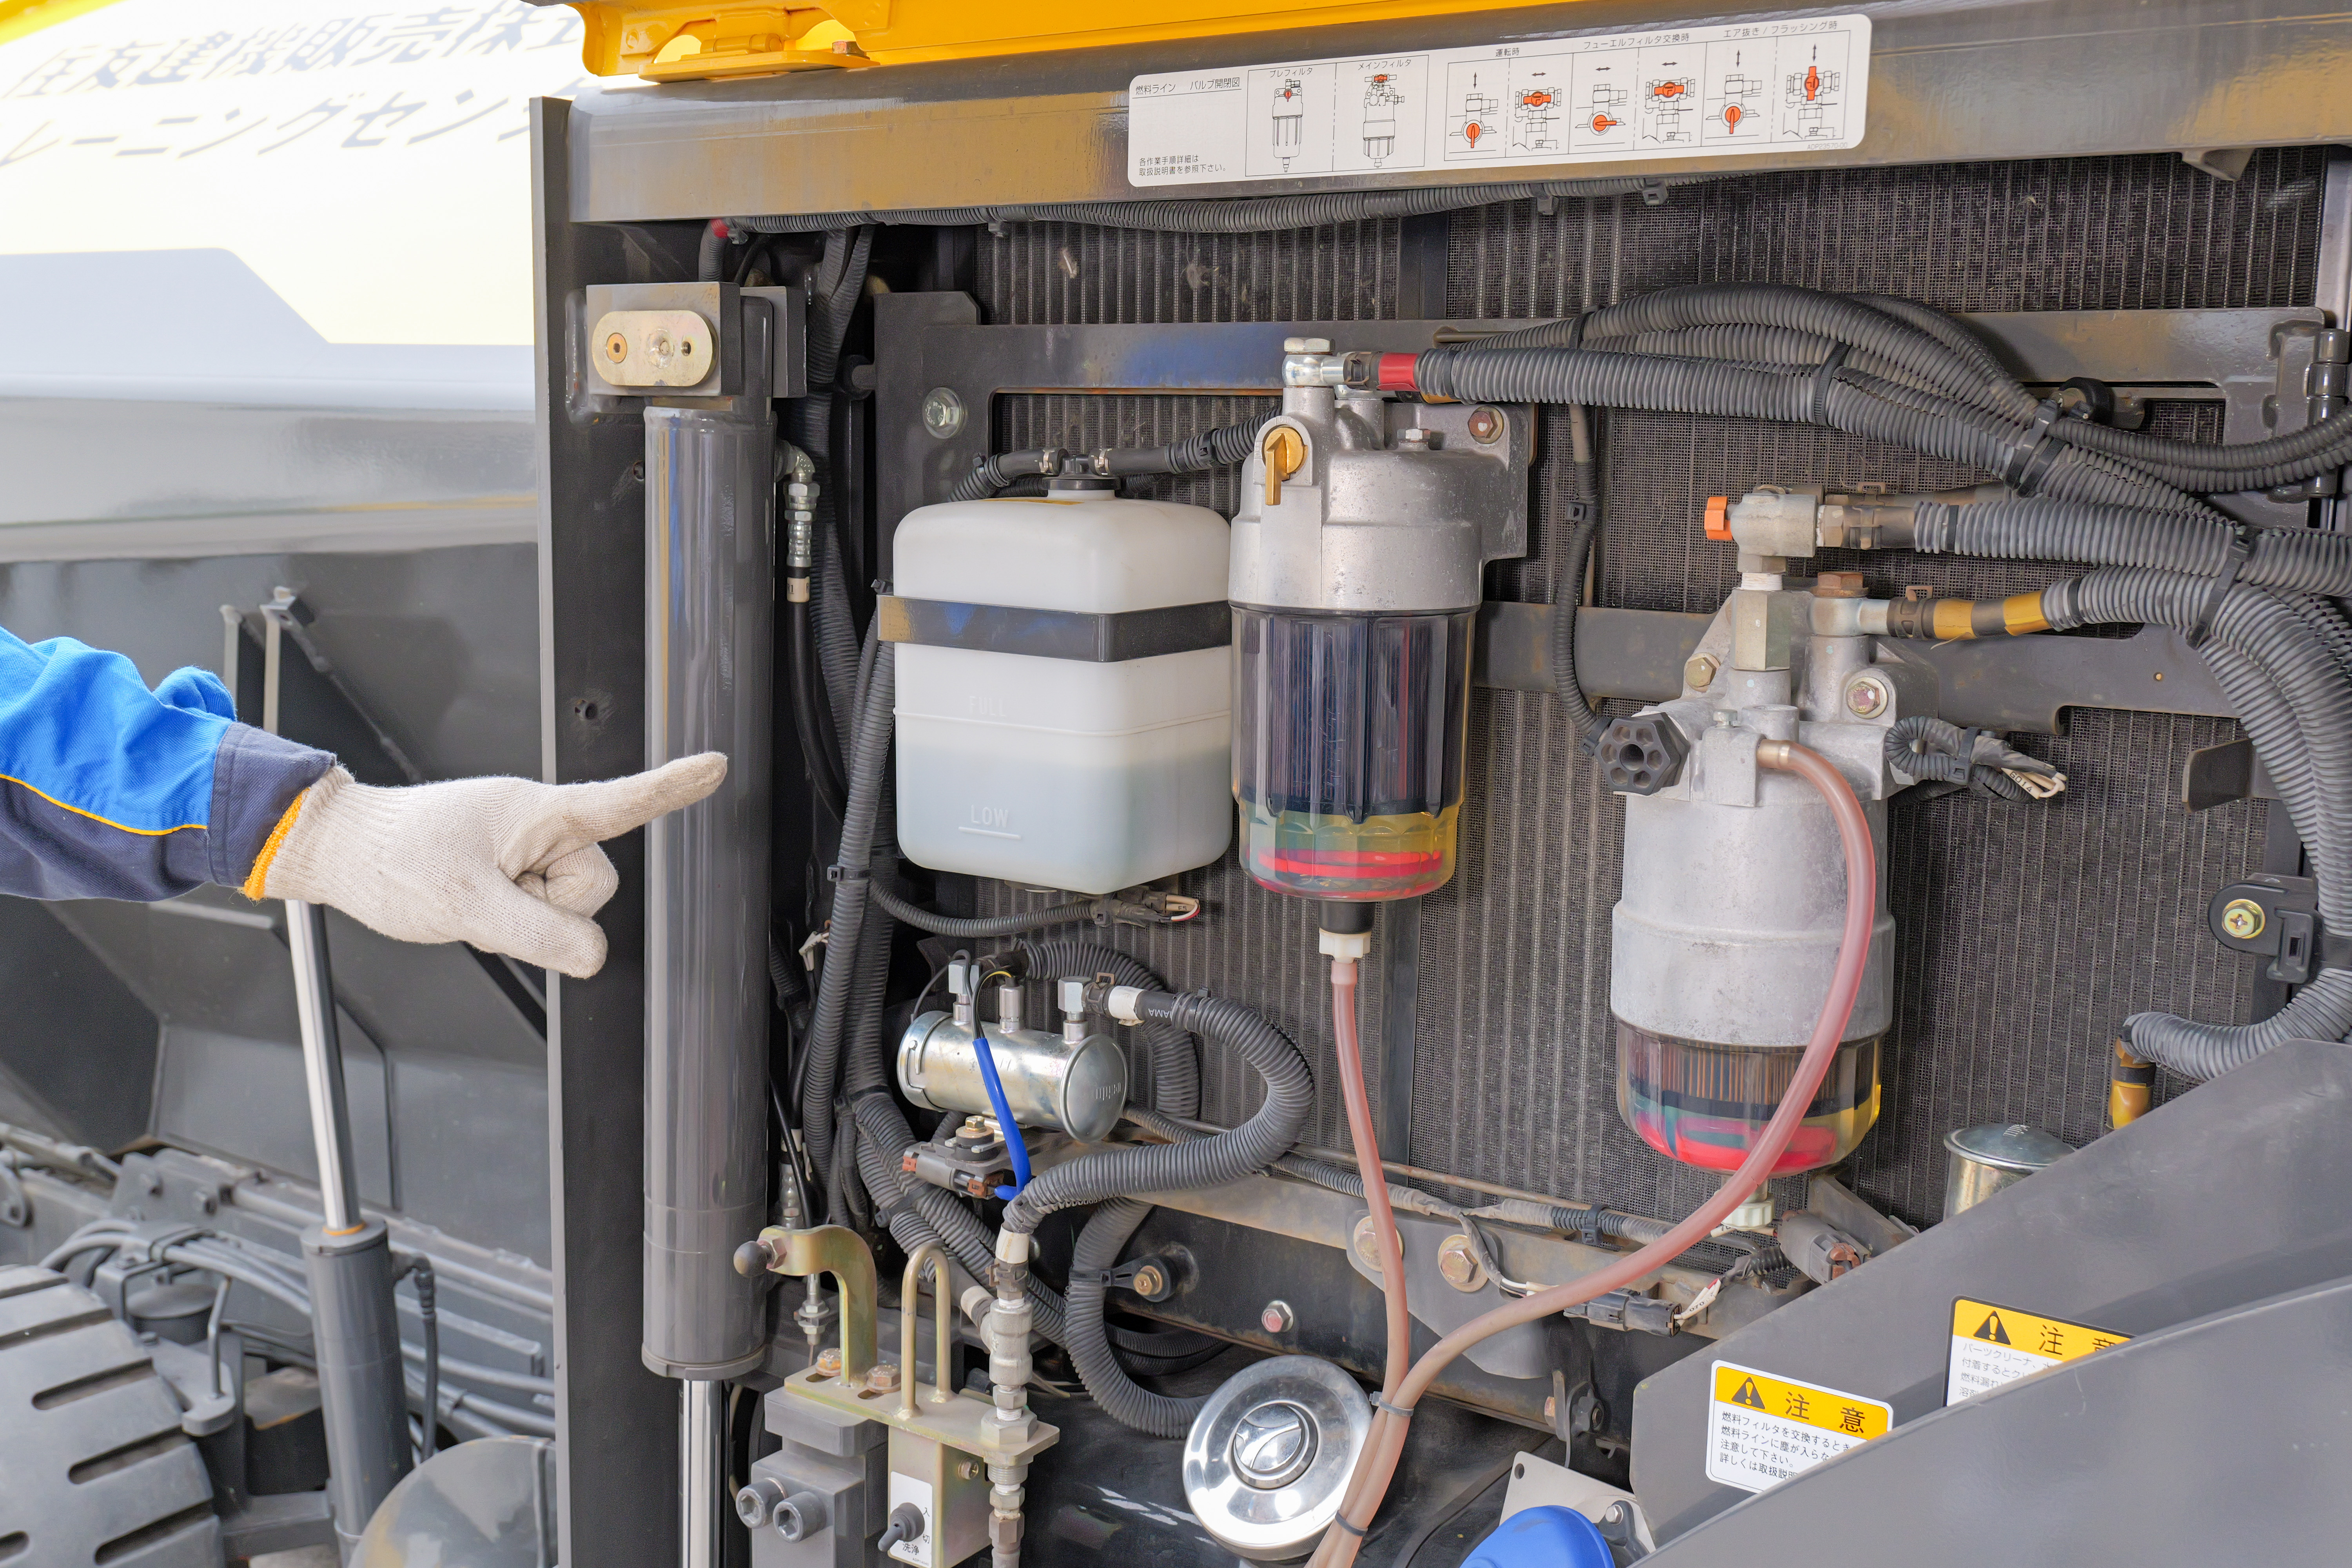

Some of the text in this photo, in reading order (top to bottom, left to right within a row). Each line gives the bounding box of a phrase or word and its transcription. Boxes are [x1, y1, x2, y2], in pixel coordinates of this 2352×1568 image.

[1724, 27, 1760, 38] エア抜き
[1771, 21, 1838, 34] フラッシング時
[1584, 33, 1690, 49] フューエルフィルタ交換時
[1495, 47, 1519, 57] 運転時
[1270, 67, 1313, 78] プレフィルタ
[1358, 59, 1412, 71] メインフィルタ
[1136, 77, 1240, 95] 燃料ライン バルブ開閉図
[1139, 154, 1199, 167] 各作業手順詳細は
[1139, 164, 1226, 176] 取扱説明書を参照下さい。
[969, 696, 1006, 717] FULL
[971, 805, 1009, 828] LOW
[1960, 1372, 2004, 1389] 燃料漏れ
[1722, 1411, 1856, 1452] 燃料フィルタを交換するとき
[1721, 1425, 1834, 1462] 燃料ラインに塵が入らな
[1720, 1439, 1793, 1468] 注意して下さい。
[923, 1507, 930, 1517] 入
[922, 1534, 930, 1544] 切
[902, 1541, 920, 1555] 洗浄
